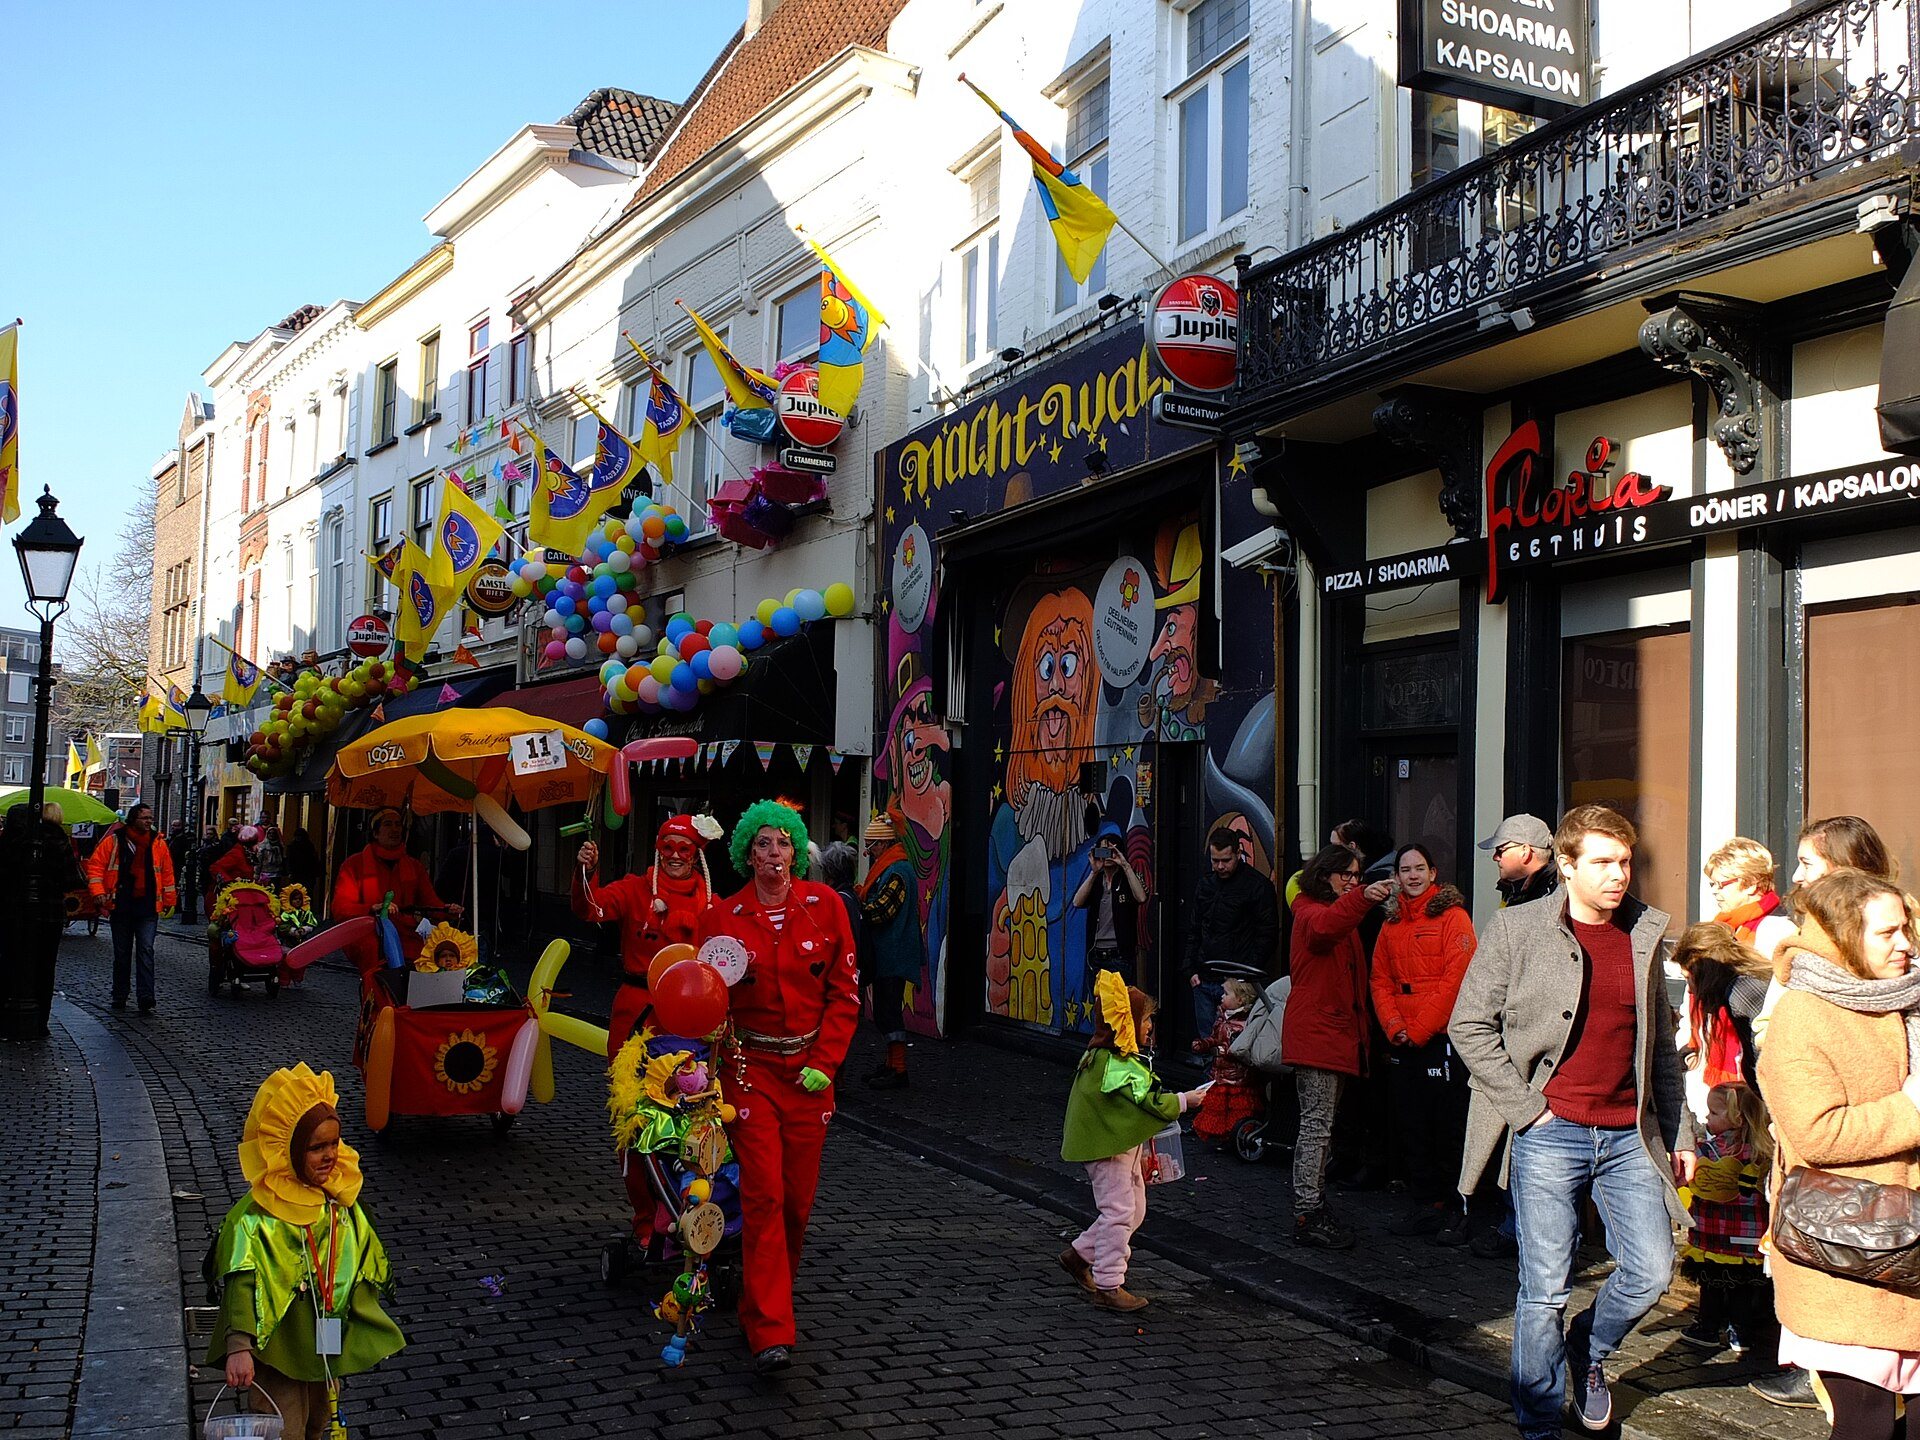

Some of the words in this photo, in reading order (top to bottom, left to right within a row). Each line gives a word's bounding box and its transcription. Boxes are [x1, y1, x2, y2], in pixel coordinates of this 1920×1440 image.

[1441, 0, 1575, 55] SHOARMA
[1436, 38, 1581, 98] KAPSALON
[1164, 402, 1176, 413] DE
[794, 455, 834, 468] STAMMENEKE
[1689, 493, 1768, 527] DÖNER
[1775, 489, 1785, 512] /
[1794, 463, 1920, 509] KAPSALON
[1510, 515, 1647, 562] EETHUIS
[1325, 571, 1363, 592] PIZZA
[1367, 566, 1373, 585] /
[1378, 554, 1450, 582] SHOARMA
[486, 589, 505, 598] BIER
[1104, 616, 1138, 646] LEUTPENNING
[1108, 606, 1139, 633] DEELNEMER
[352, 631, 387, 642] Jupiler
[456, 733, 492, 747] Fruit
[526, 735, 552, 760] 11
[1427, 1068, 1442, 1077] KFK
